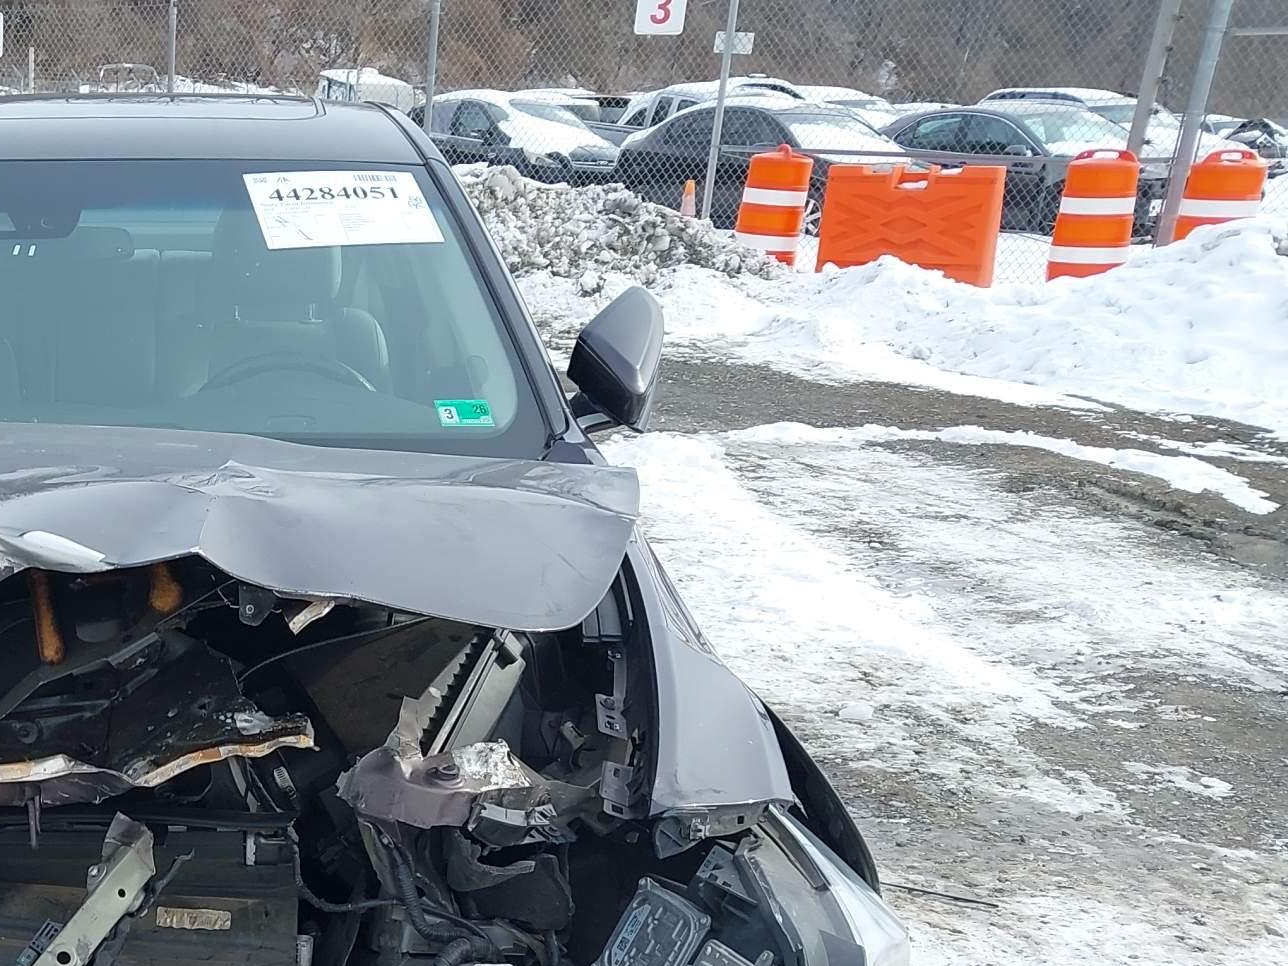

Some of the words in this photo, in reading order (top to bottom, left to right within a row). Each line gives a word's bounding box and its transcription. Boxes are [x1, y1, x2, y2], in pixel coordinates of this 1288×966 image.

[650, 0, 673, 24] 3
[268, 186, 399, 202] 44284051
[443, 408, 455, 420] 3
[472, 403, 488, 415] 26
